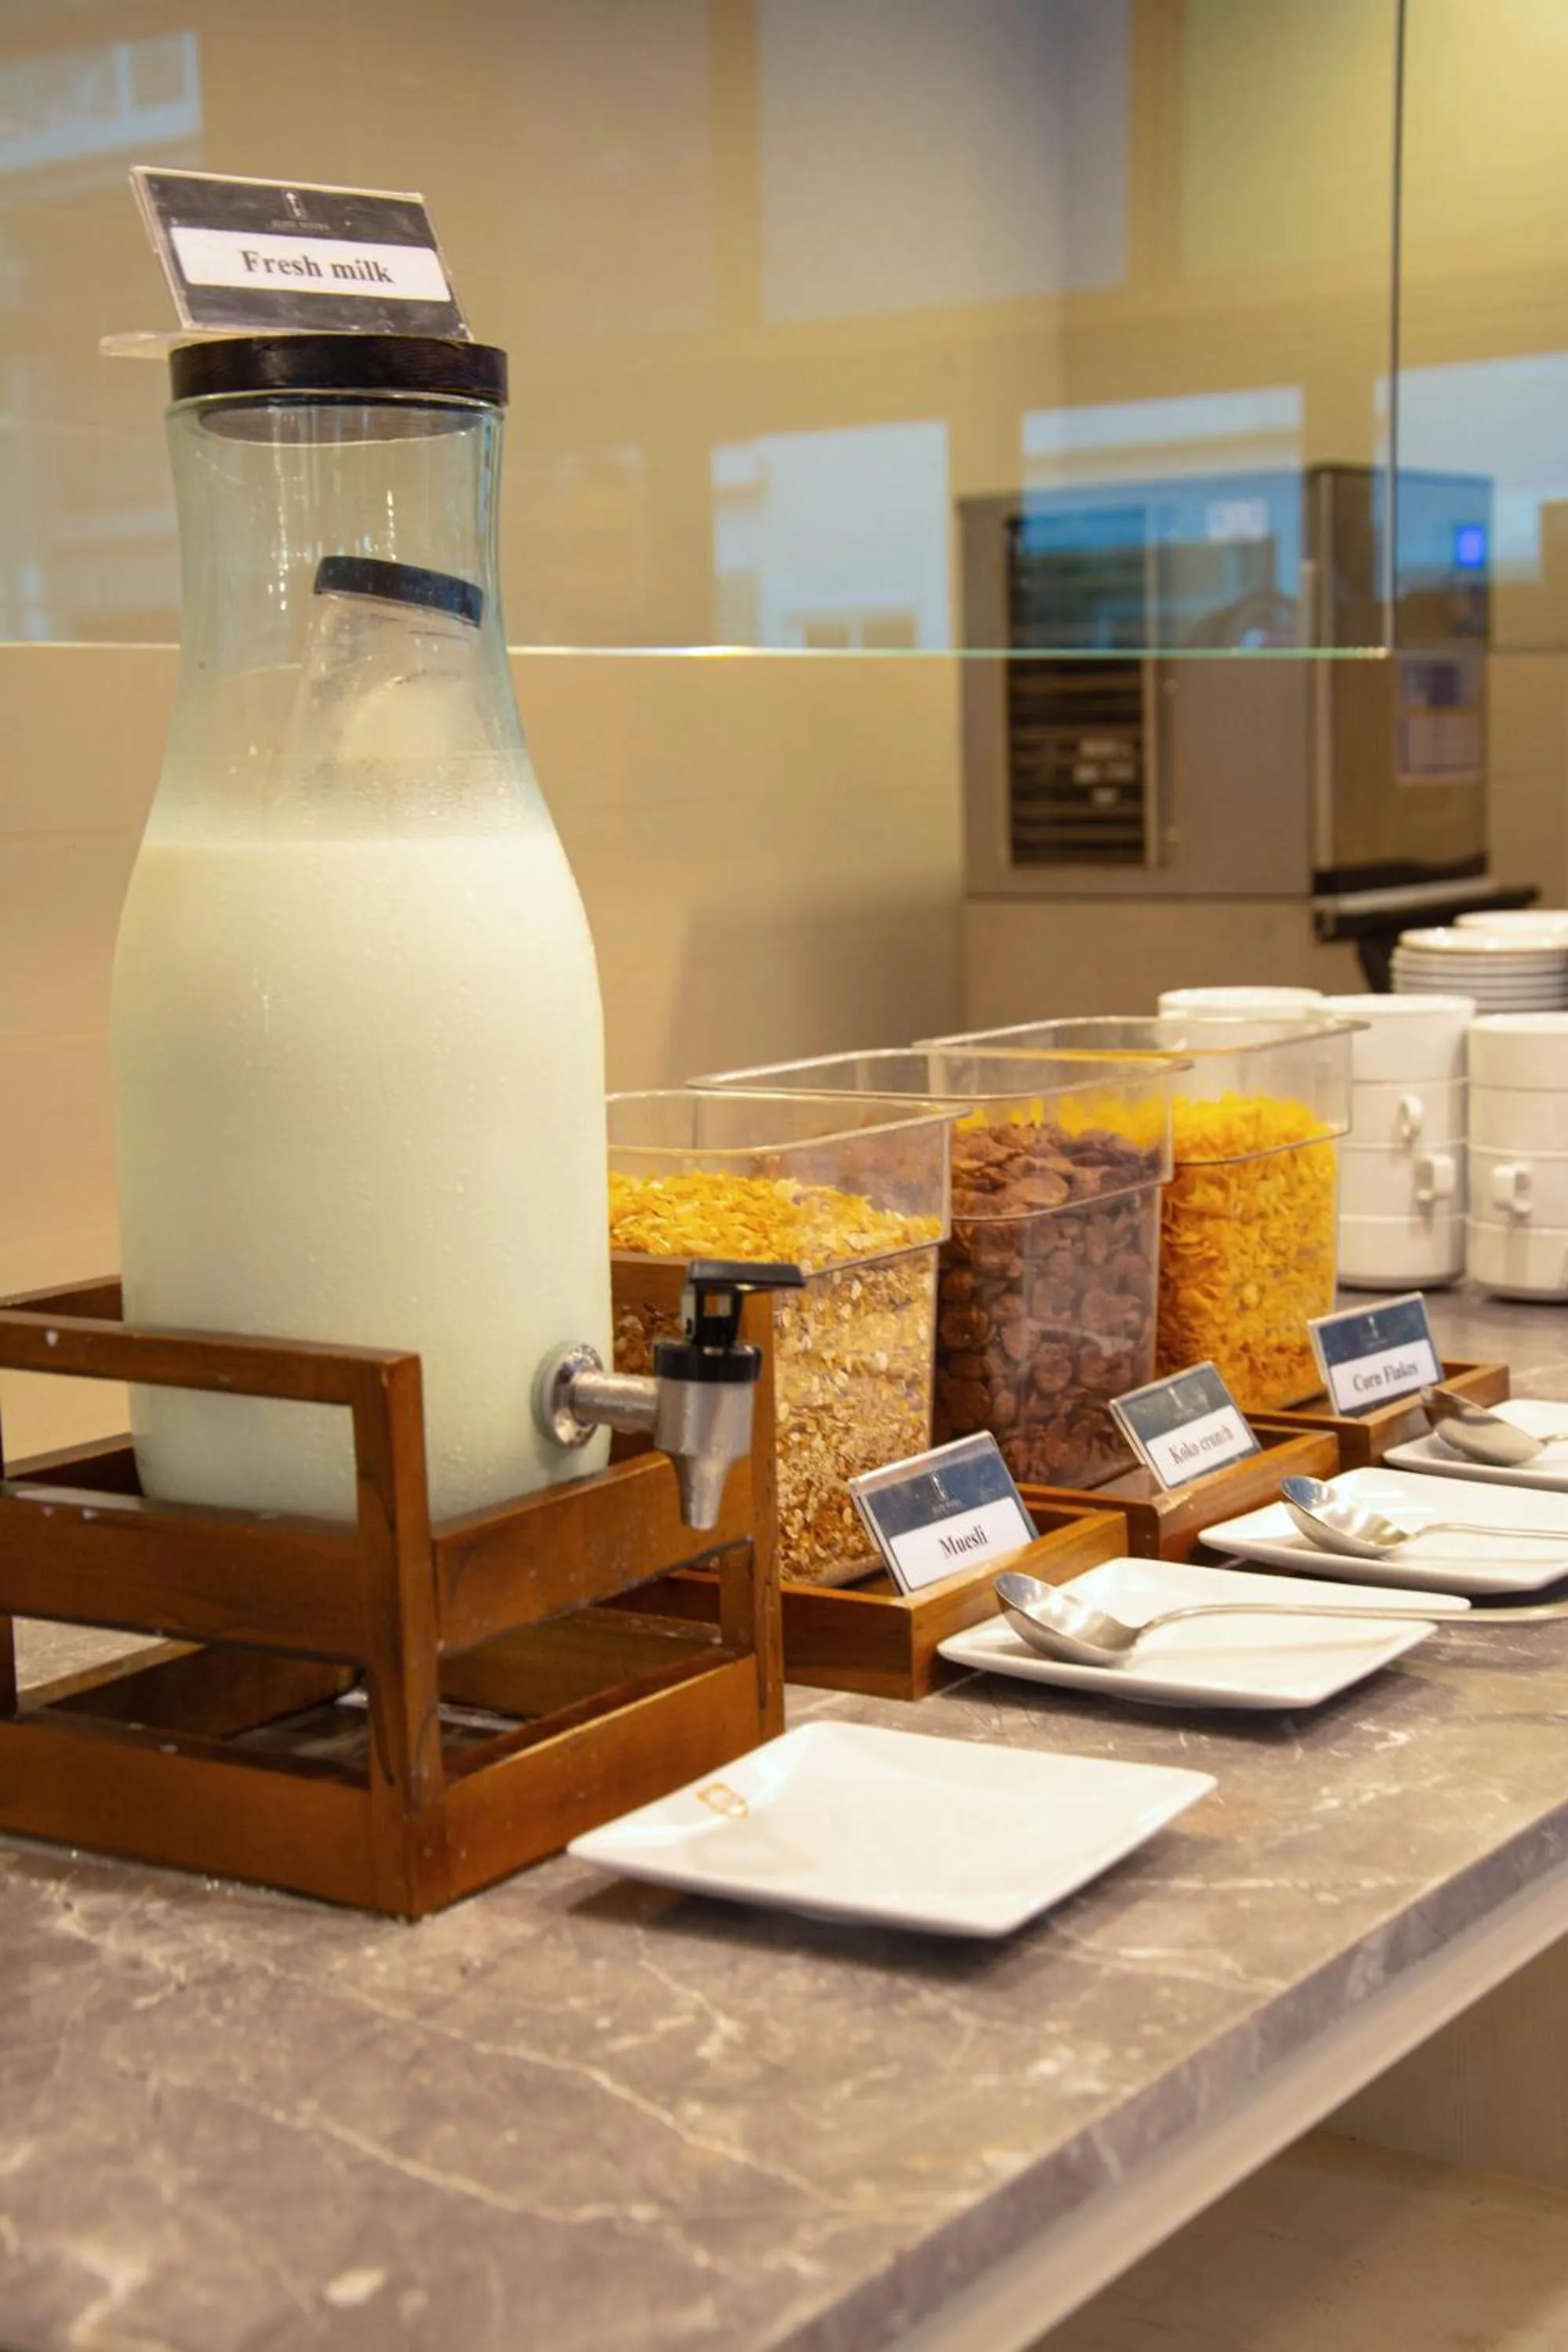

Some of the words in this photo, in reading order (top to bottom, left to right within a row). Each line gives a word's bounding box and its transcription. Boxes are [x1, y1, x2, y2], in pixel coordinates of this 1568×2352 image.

[240, 250, 324, 278] Fresh
[330, 259, 394, 283] milk
[1352, 1374, 1383, 1393] Corn
[1382, 1361, 1419, 1384] Flakes
[938, 1525, 989, 1558] Muesli
